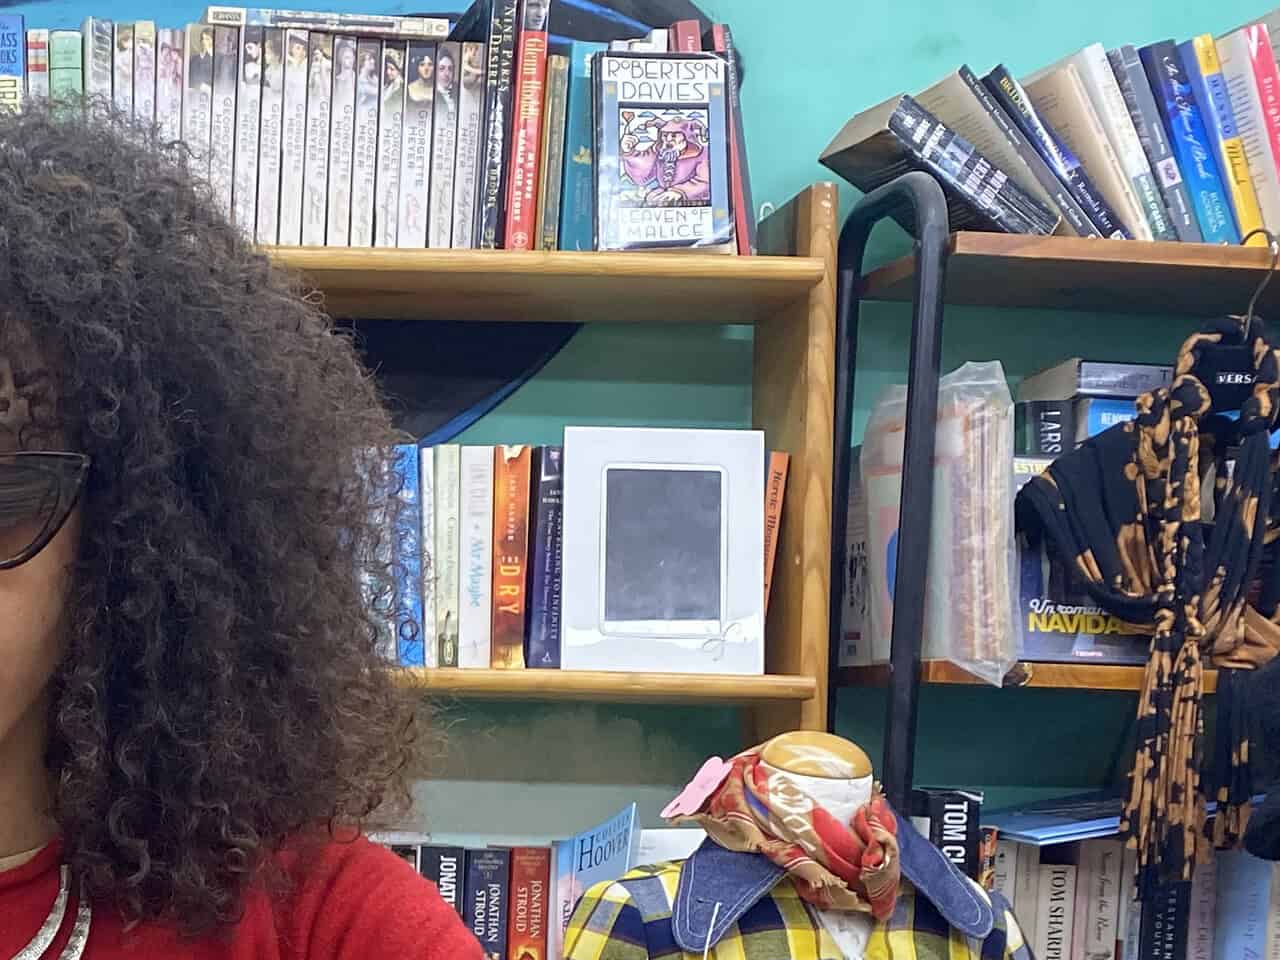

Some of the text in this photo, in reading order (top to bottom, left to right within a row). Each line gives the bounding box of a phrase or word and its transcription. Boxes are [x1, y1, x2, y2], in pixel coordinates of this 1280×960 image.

[487, 34, 503, 86] DESIRE
[498, 5, 516, 93] NINE PARTS
[524, 38, 545, 76] Glenn
[607, 58, 719, 80] ROBERTSON
[622, 81, 705, 101] DAVIES
[1000, 76, 1031, 118] BRIDGE
[356, 125, 366, 169] HEYER
[364, 108, 377, 185] GEORGETTE
[382, 128, 392, 171] HEYER
[389, 111, 401, 188] GEORGETTE
[406, 126, 417, 169] HEYER
[415, 110, 428, 188] GEORGETTE
[436, 127, 445, 170] HEYER
[444, 110, 456, 186] GEORGETTE
[459, 127, 469, 168] HEYER
[464, 112, 478, 185] GEORGETTE
[1039, 409, 1063, 453] LARS
[467, 539, 485, 608] Mr Maybe
[497, 564, 521, 616] DRY
[550, 593, 561, 641] INFINITY
[942, 801, 969, 839] TOM
[1051, 868, 1067, 898] TOM
[473, 888, 488, 937] STROUD
[486, 882, 502, 943] JONATHAN
[515, 886, 528, 933] STROUD
[529, 880, 543, 939] JONATHAN
[1151, 912, 1163, 957] YOUTH
